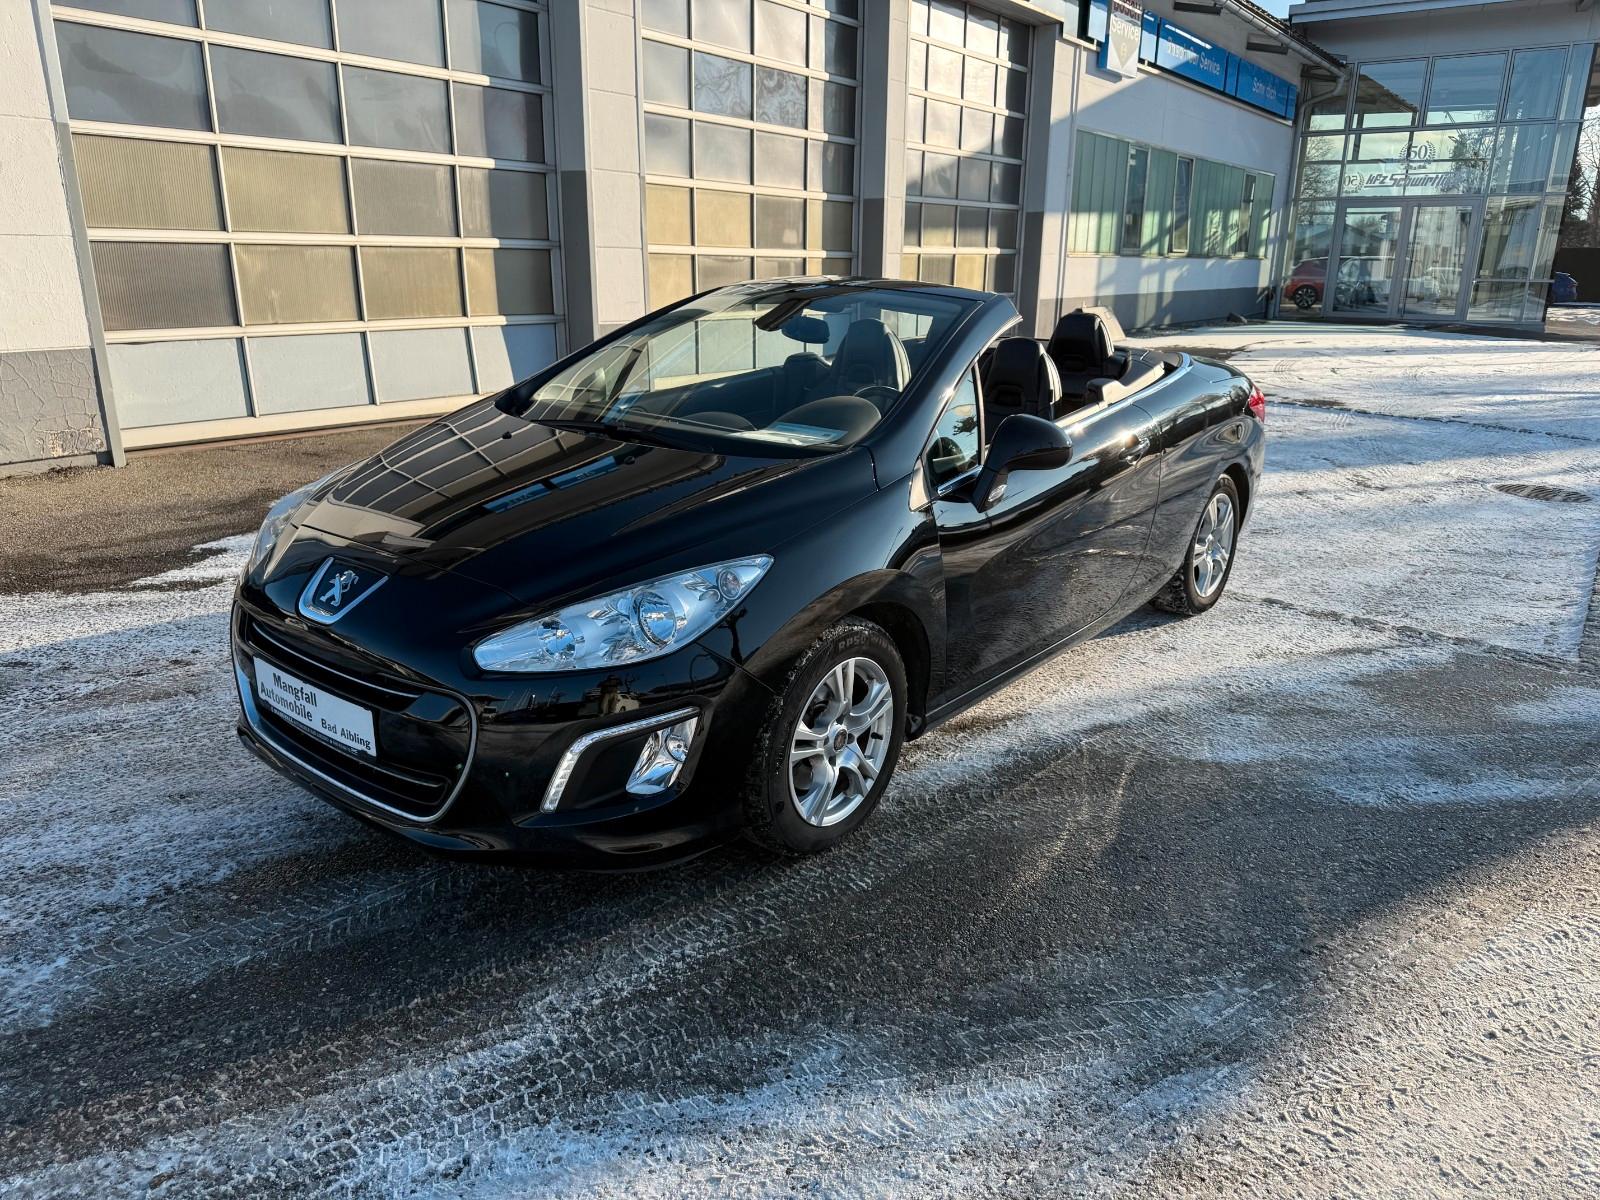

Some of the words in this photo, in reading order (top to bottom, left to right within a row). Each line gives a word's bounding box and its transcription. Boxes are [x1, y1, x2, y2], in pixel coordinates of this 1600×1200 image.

[1111, 17, 1139, 41] Service
[1200, 51, 1220, 75] Service
[1409, 144, 1429, 160] 50
[260, 682, 313, 721] Automobile
[272, 672, 318, 707] Mangfall
[320, 718, 338, 734] Bad
[340, 728, 371, 751] Aibling
